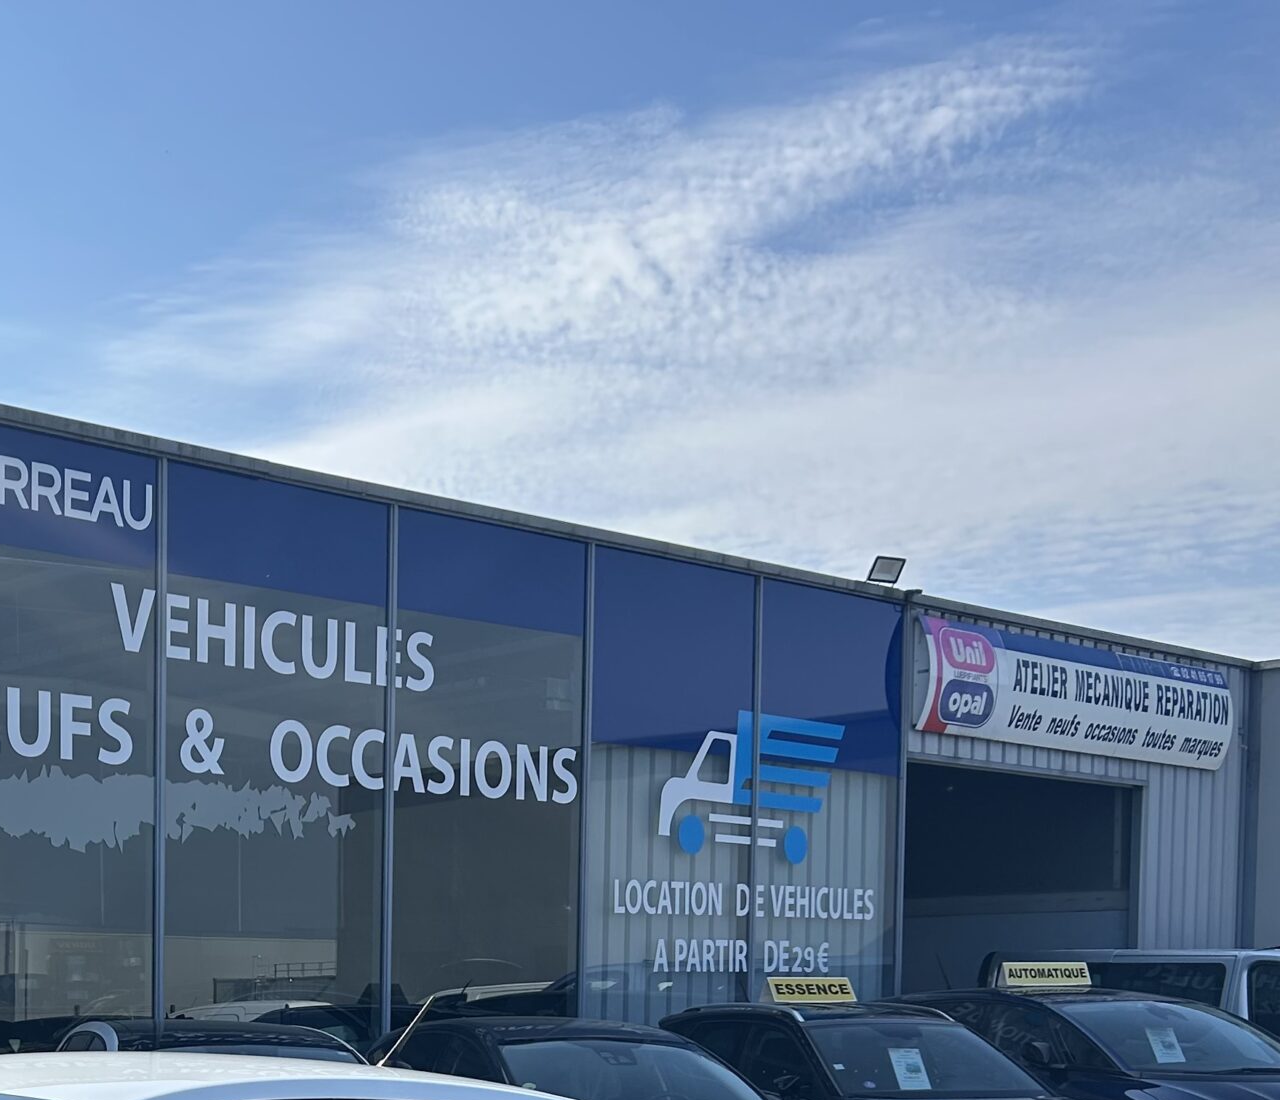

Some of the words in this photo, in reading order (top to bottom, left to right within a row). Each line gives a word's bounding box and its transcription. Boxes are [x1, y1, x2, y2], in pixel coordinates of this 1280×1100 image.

[110, 582, 435, 692] VEHICULES
[949, 637, 987, 667] Unil
[948, 691, 988, 718] opal
[1013, 658, 1067, 700] ATELIER
[1075, 669, 1149, 713] MECANIQUE
[1156, 684, 1229, 726] REPARATION
[1007, 704, 1043, 731] Vente
[1046, 712, 1080, 738] neufs
[1084, 719, 1138, 745] occasions
[1142, 726, 1176, 752] toutes
[1179, 737, 1224, 760] marques
[179, 708, 225, 775] &
[269, 718, 579, 805] OCCASIONS
[613, 879, 723, 916] LOCATION
[736, 883, 765, 918] DE
[769, 885, 875, 921] VEHICULES
[653, 939, 669, 973] A
[674, 938, 748, 973] PARTIR
[1008, 967, 1088, 980] AUTOMATIQUE
[773, 983, 851, 996] ESSENCE
